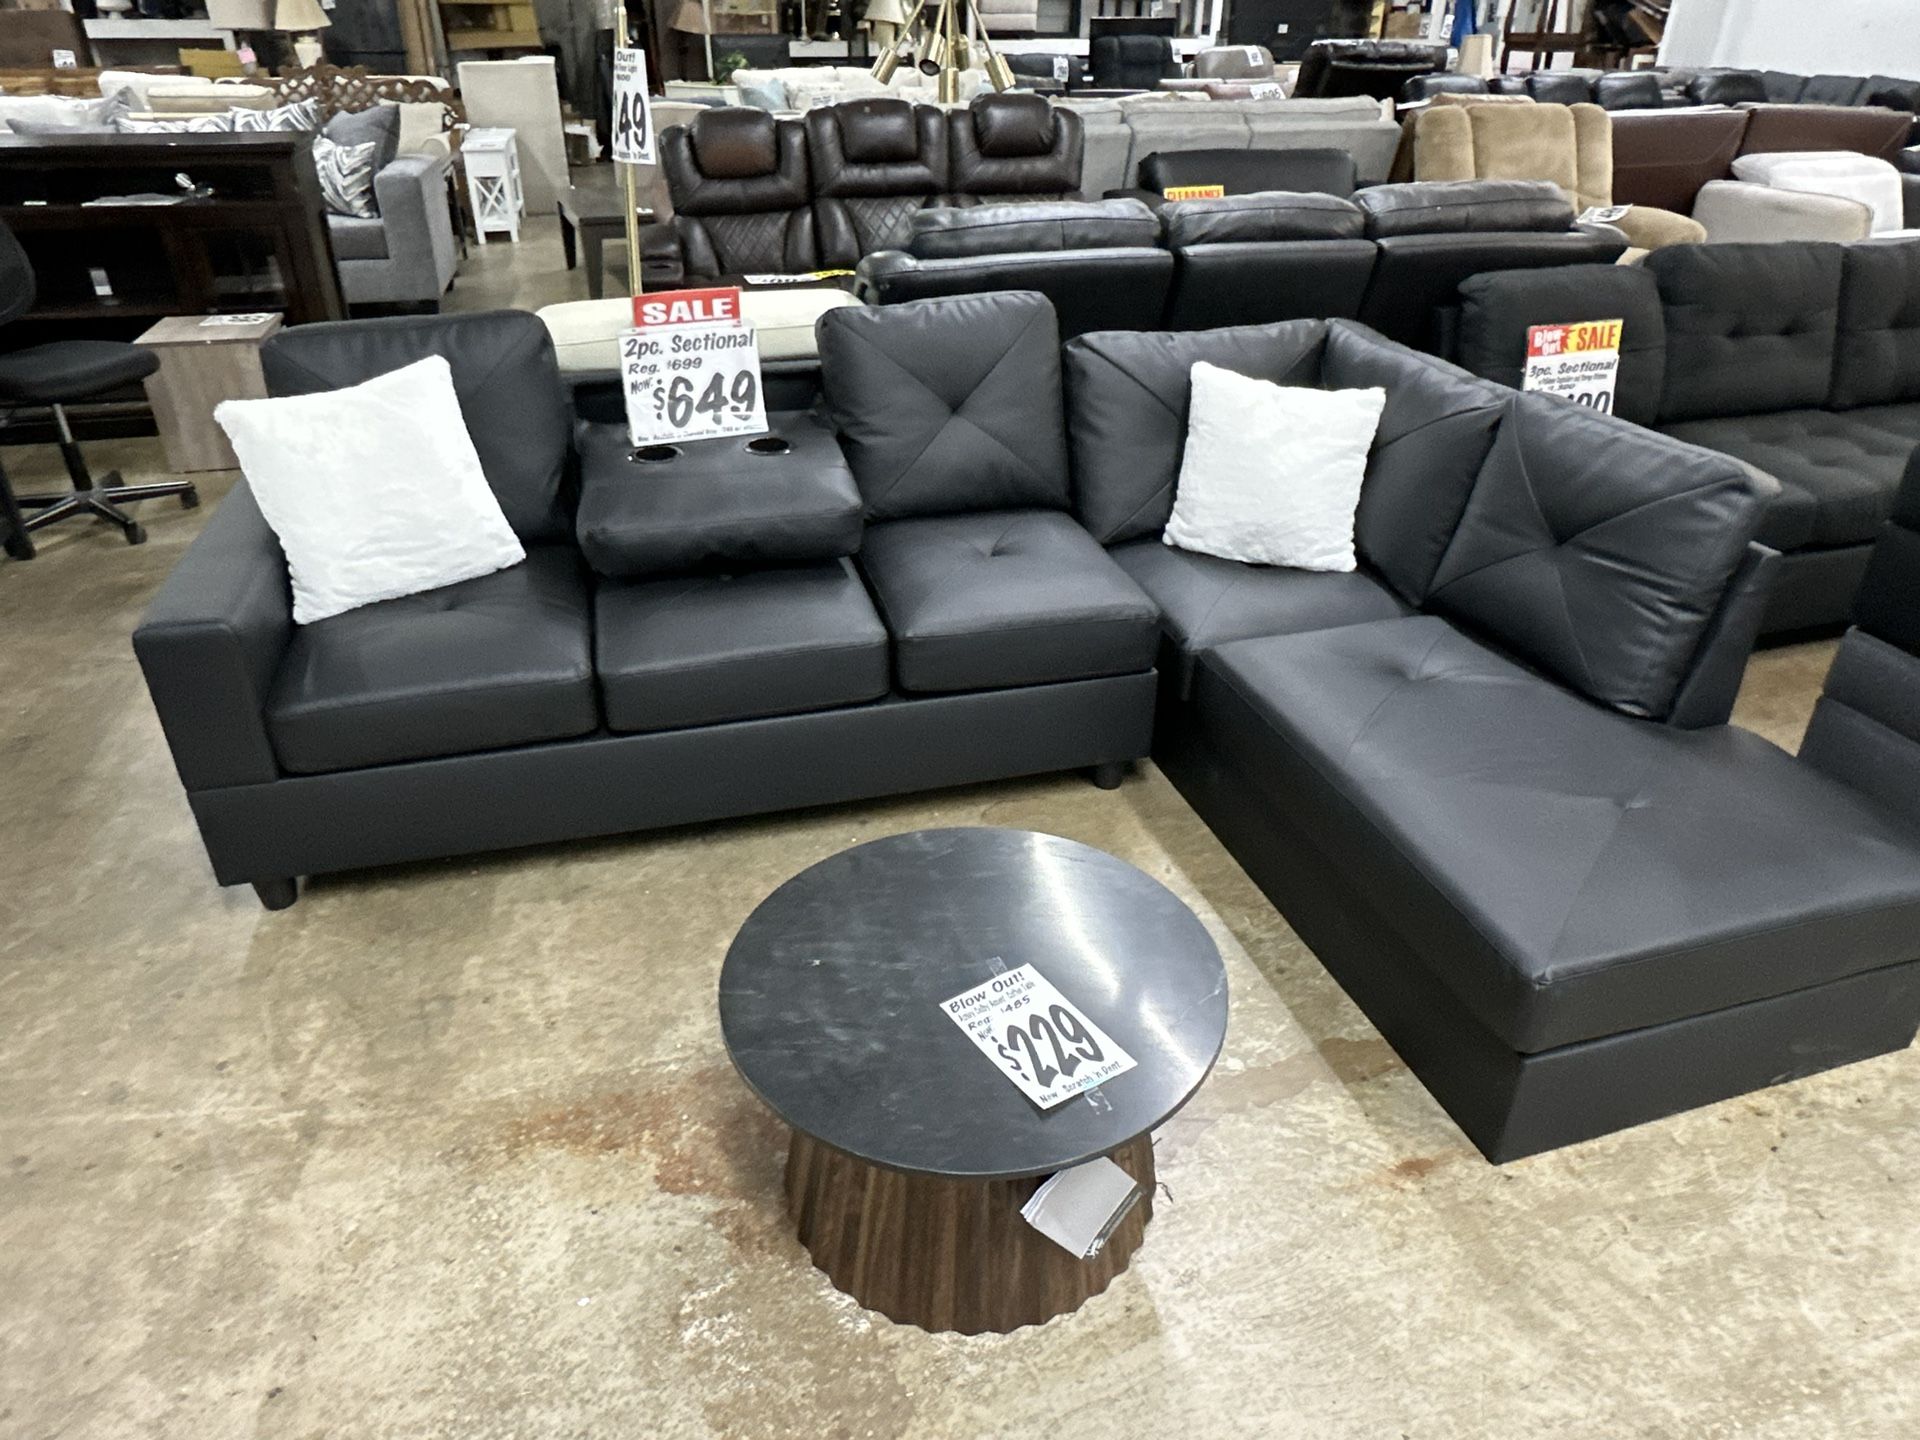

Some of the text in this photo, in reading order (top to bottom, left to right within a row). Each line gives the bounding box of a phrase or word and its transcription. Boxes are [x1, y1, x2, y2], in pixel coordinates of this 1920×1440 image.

[642, 298, 733, 323] SALE
[624, 328, 754, 359] 2pc. Sectional
[1576, 325, 1617, 352] SALE
[667, 357, 703, 371] $699
[1557, 358, 1617, 374] Sectional
[653, 369, 757, 429] $649
[949, 990, 986, 1013] Blow
[991, 971, 1025, 993] Out!
[991, 1004, 1105, 1088] $229
